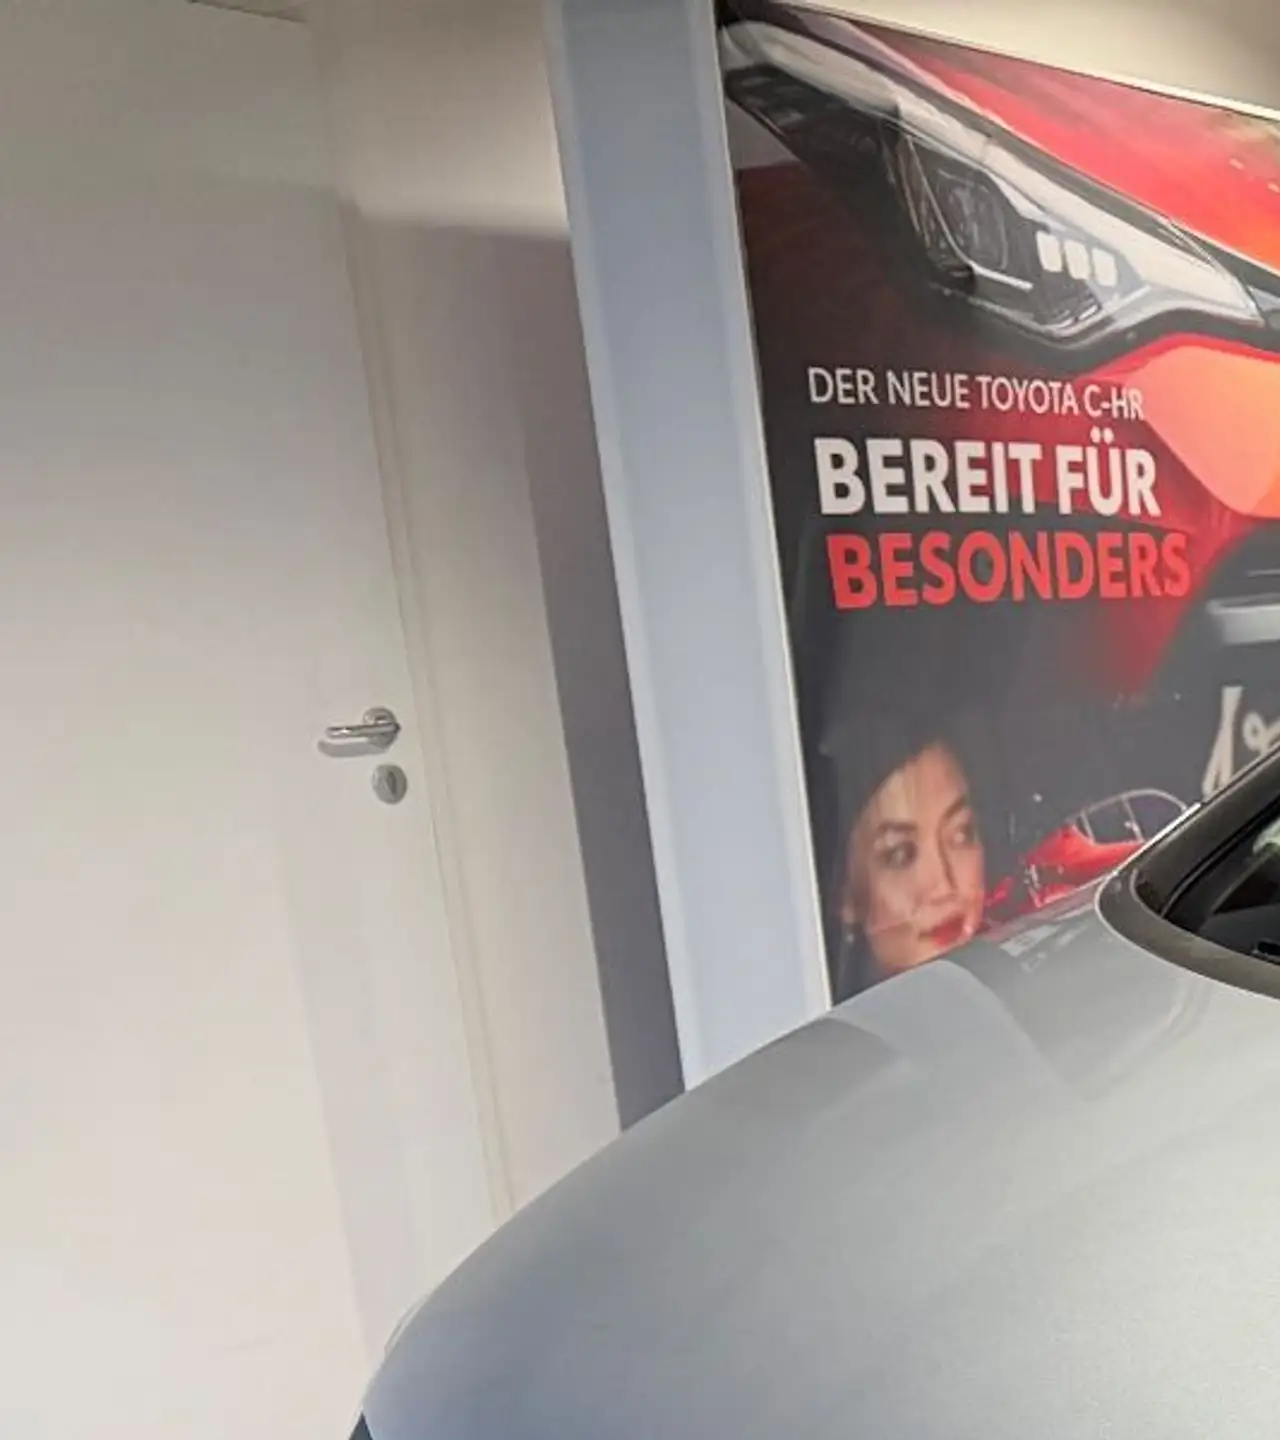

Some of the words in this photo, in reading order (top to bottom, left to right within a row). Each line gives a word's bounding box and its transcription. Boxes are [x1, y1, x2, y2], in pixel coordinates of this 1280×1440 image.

[808, 367, 879, 405] DER
[886, 370, 971, 409] NEUE
[975, 375, 1079, 416] TOYOTA
[1083, 384, 1145, 421] C-HR
[814, 437, 1043, 515] BEREIT
[1055, 425, 1162, 517] FÜR
[827, 529, 1190, 609] BESONDERS
